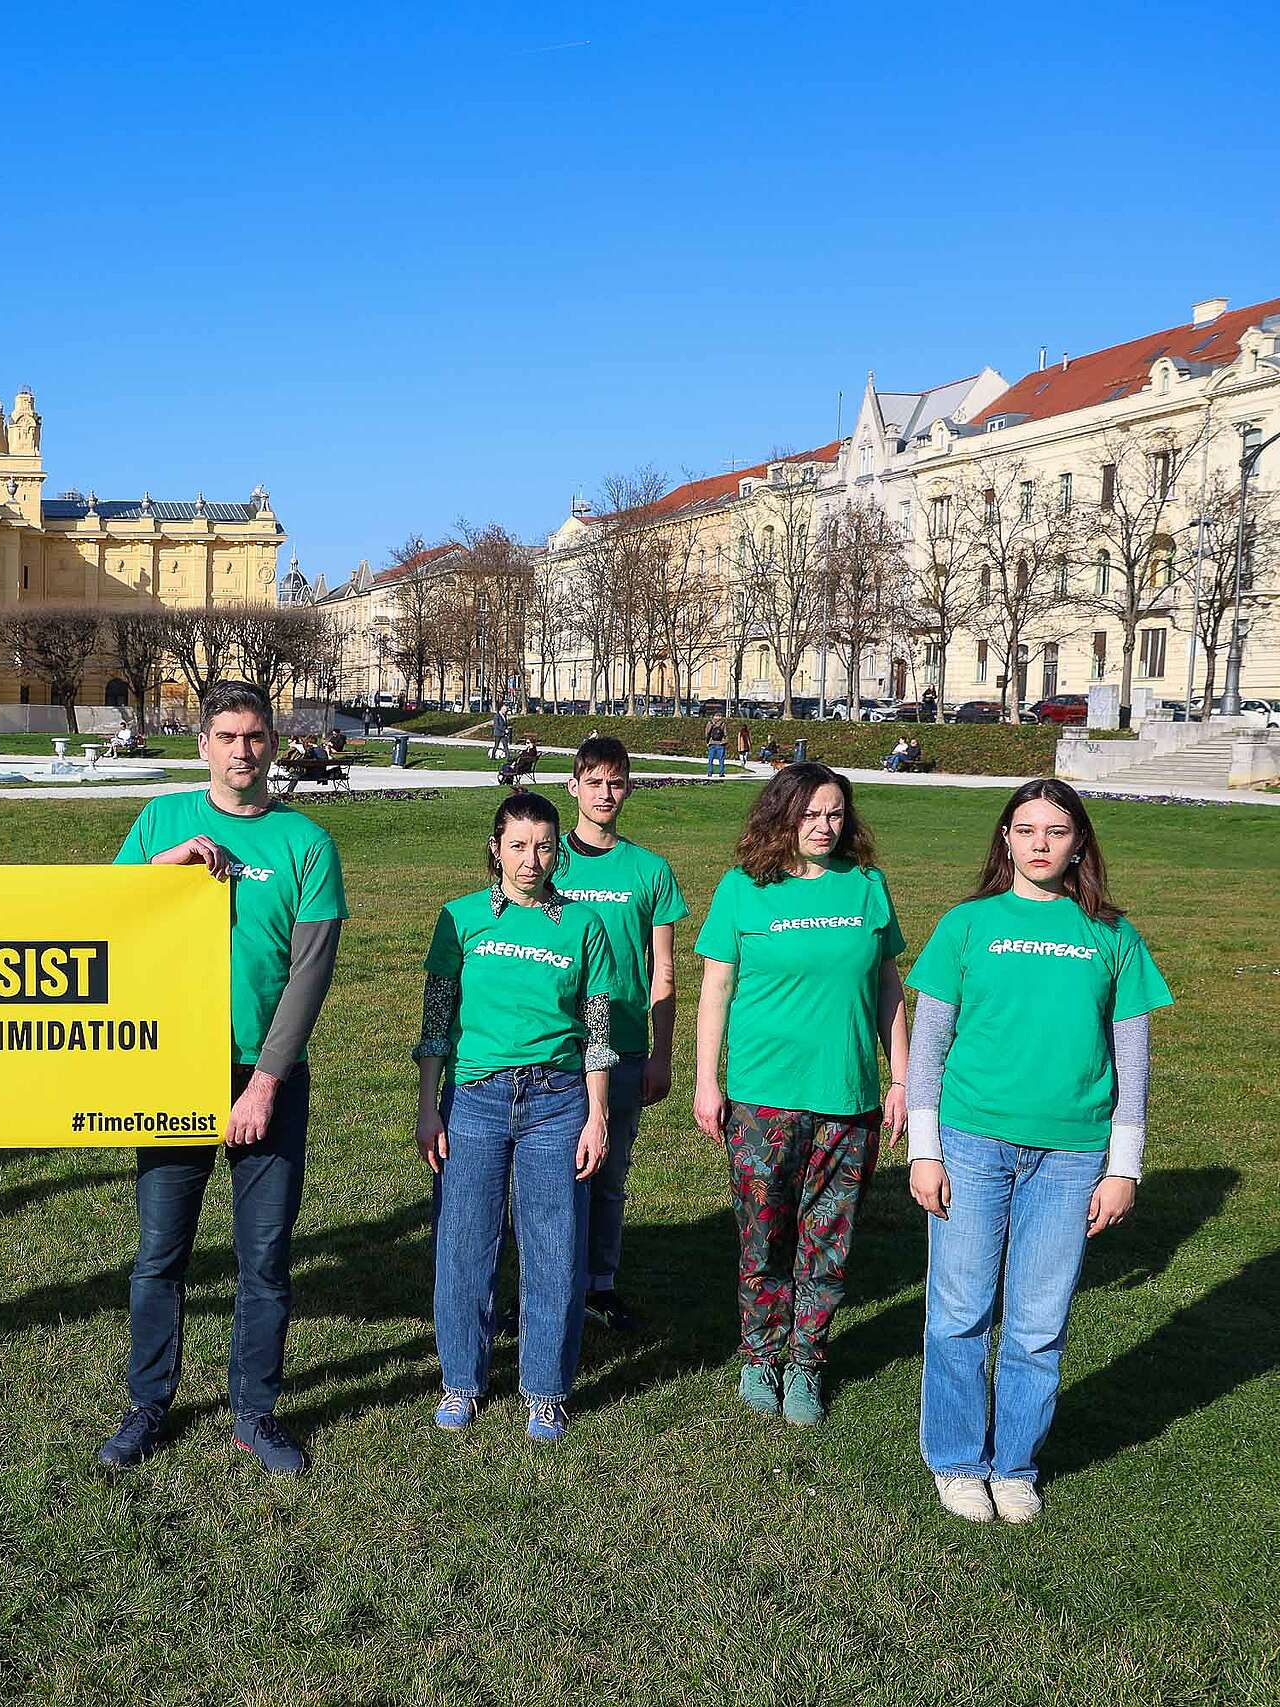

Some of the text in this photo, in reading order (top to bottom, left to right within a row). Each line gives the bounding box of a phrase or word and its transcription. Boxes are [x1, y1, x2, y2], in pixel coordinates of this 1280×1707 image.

[556, 888, 633, 903] REENPEACE
[769, 915, 865, 933] GREENPEACE
[473, 939, 573, 969] GREENPEACE
[988, 939, 1098, 960] GREENPEACE
[71, 1111, 217, 1132] #TimeToResist
